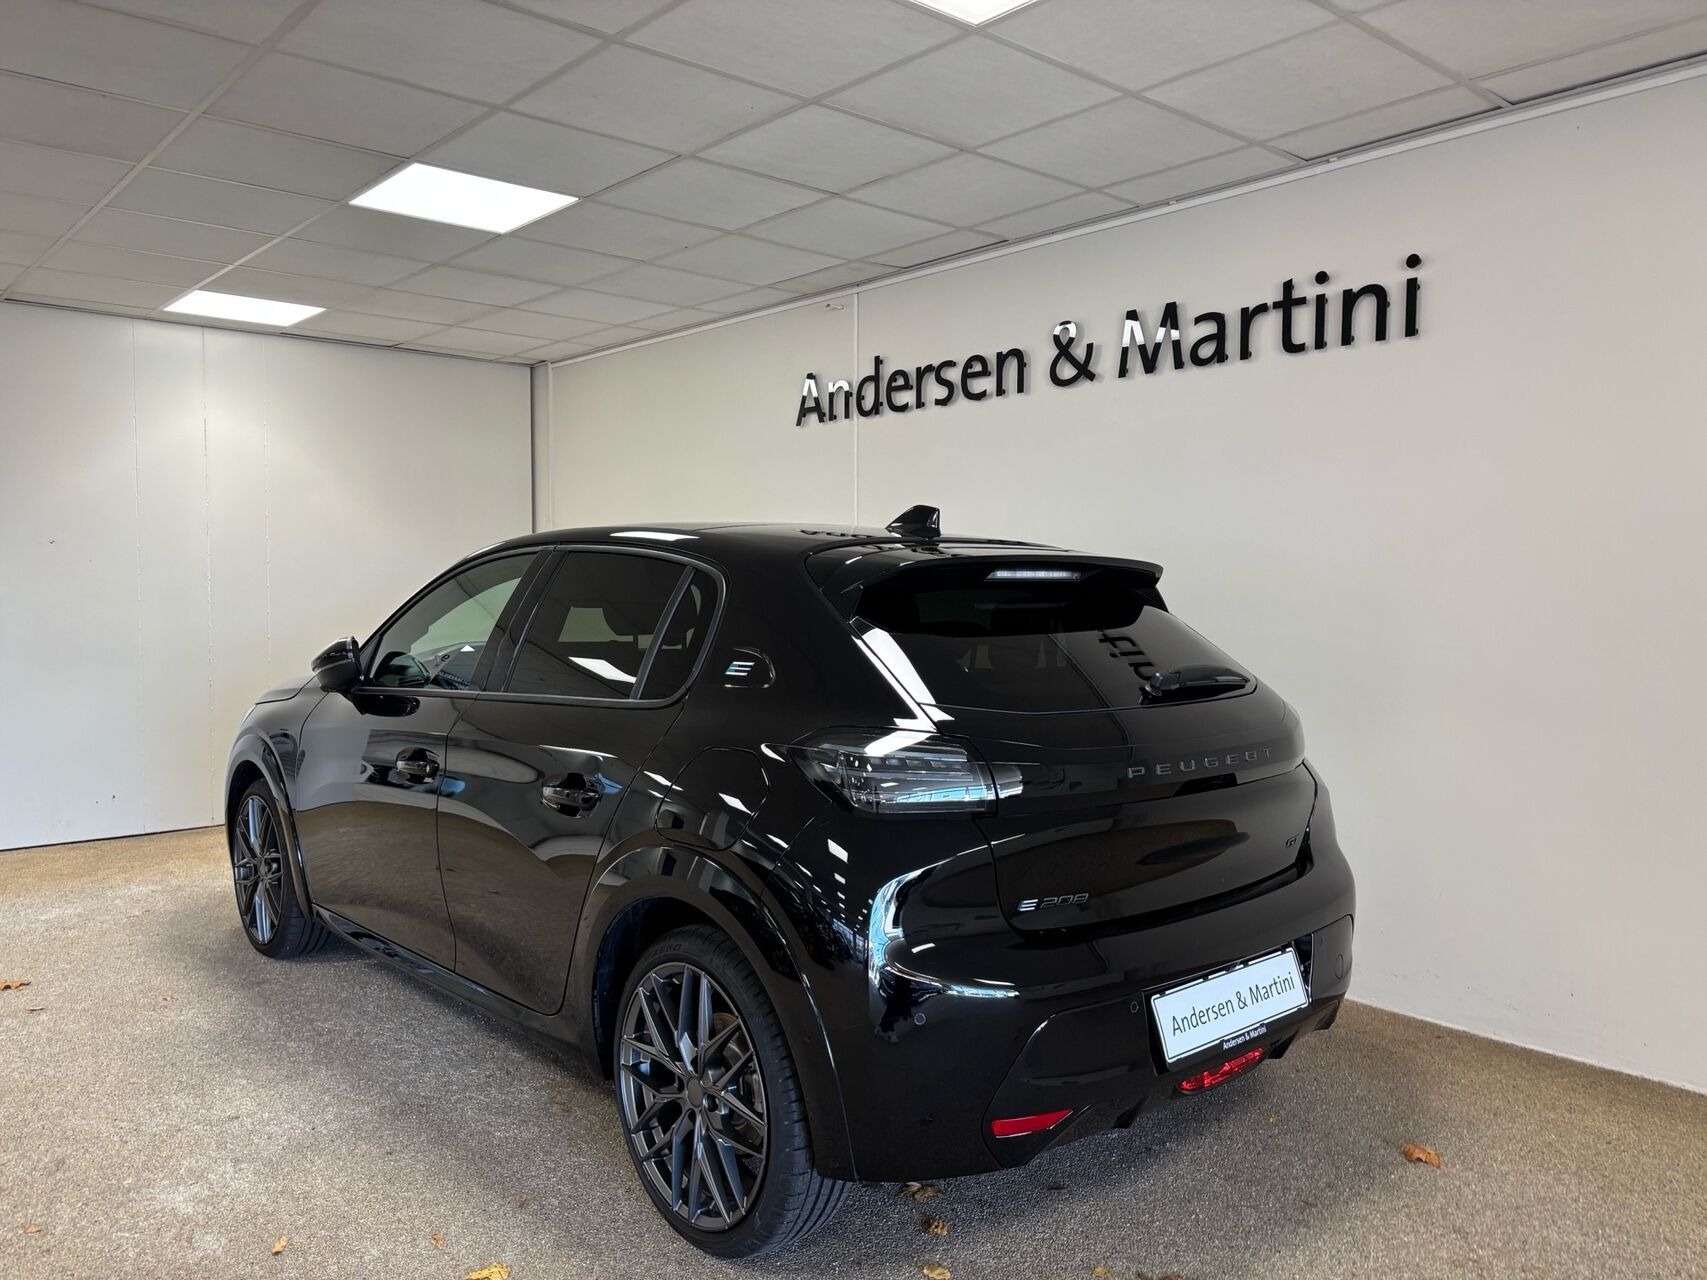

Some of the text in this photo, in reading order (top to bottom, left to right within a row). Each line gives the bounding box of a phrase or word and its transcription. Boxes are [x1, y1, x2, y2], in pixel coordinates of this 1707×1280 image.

[796, 253, 1421, 427] Andersen & Martini
[1127, 746, 1273, 780] PEUGEOT
[1172, 971, 1296, 1037] Andersen & Martini
[1223, 1035, 1246, 1051] Andersen
[1250, 1025, 1267, 1039] Martini
